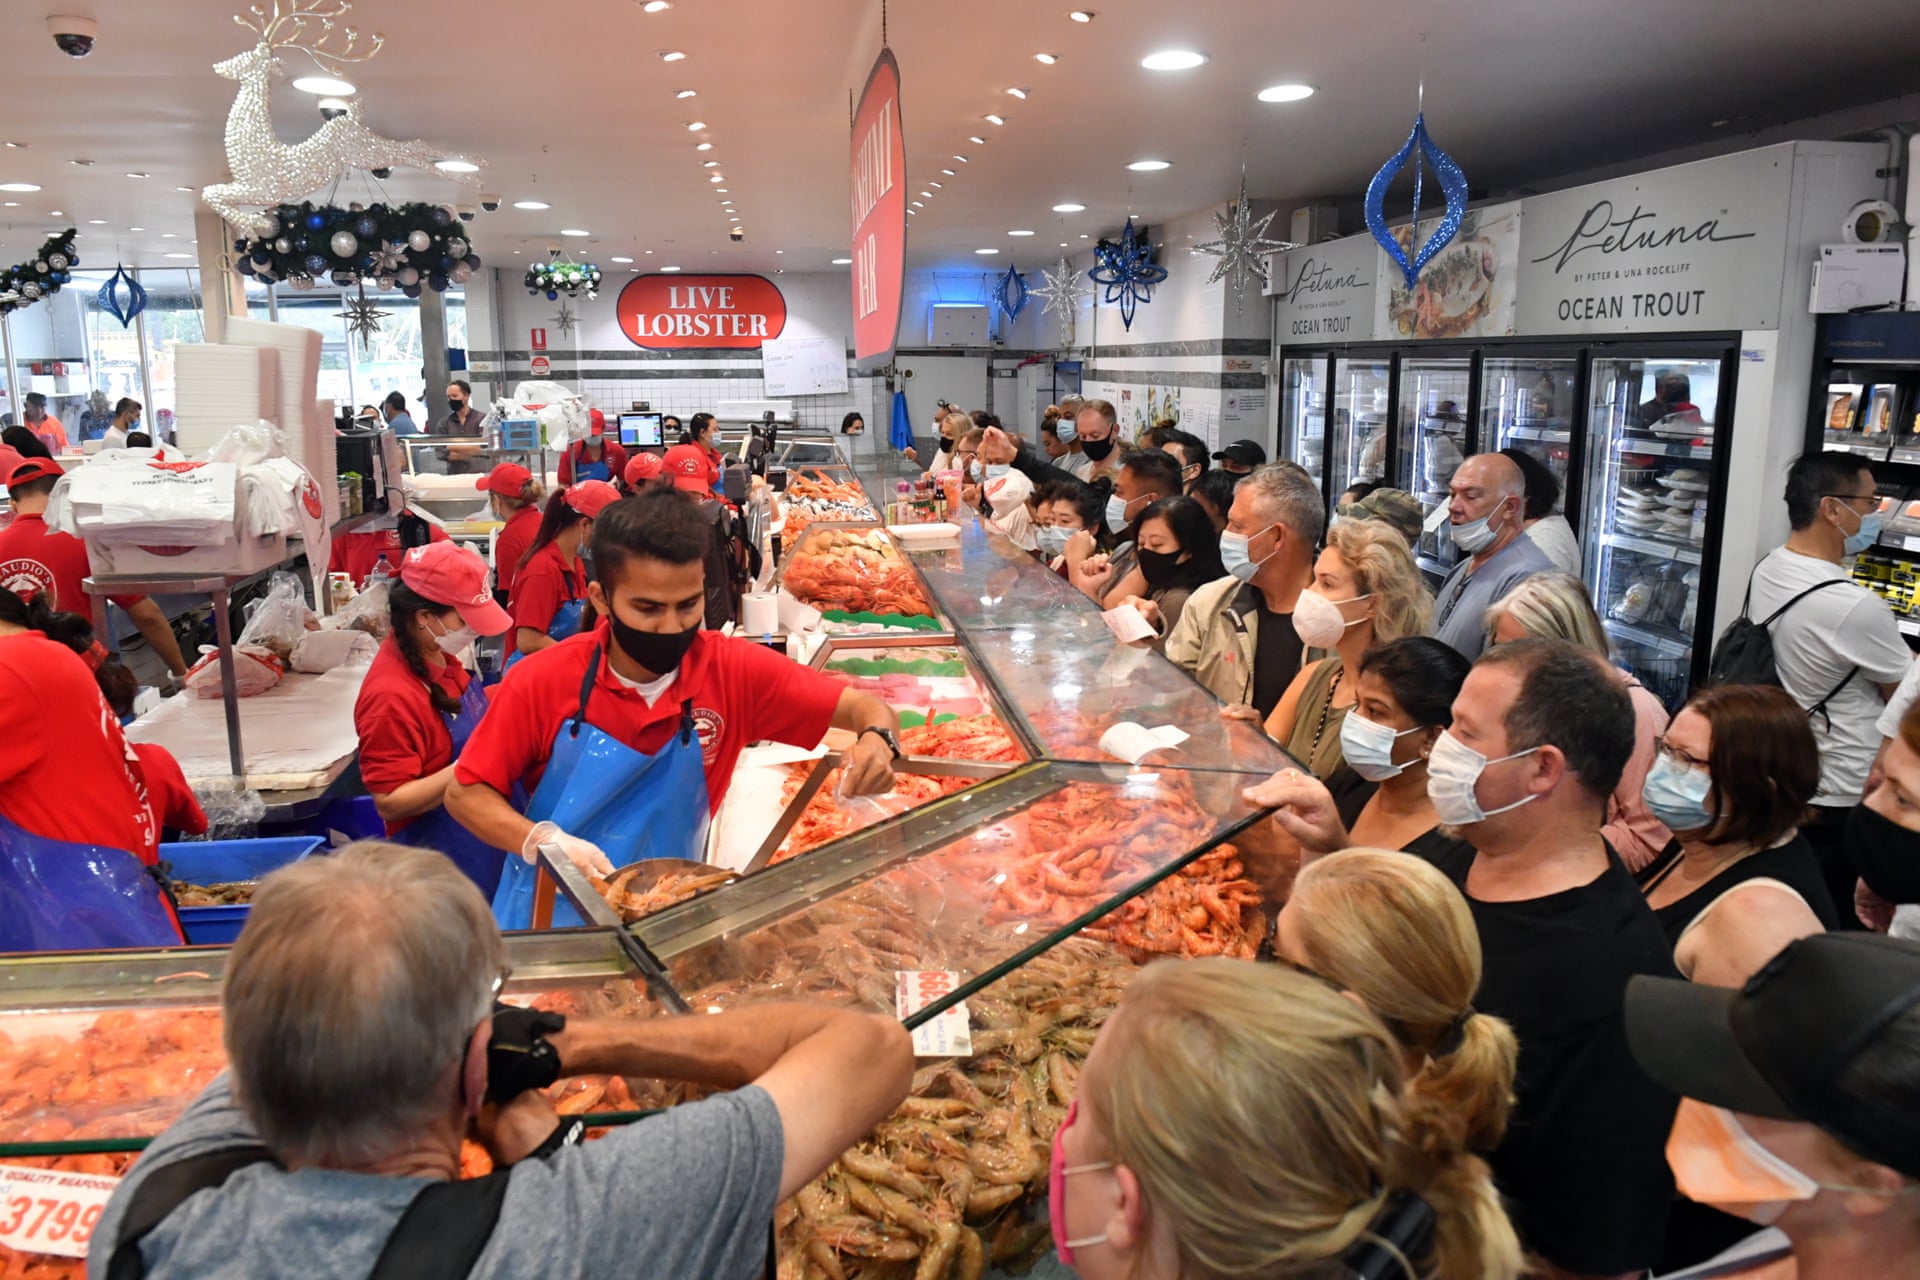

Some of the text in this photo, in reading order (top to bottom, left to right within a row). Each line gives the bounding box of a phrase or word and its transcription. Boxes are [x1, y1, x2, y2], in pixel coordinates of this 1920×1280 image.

[850, 98, 893, 241] ASHIMI
[1531, 200, 1756, 274] Petuna
[858, 234, 878, 319] BAR
[1283, 258, 1370, 304] Petuna
[1574, 263, 1690, 282] BY PETER & UNA ROCKLIFF
[669, 286, 735, 309] LIVE
[1558, 290, 1705, 321] OCEAN TROUT
[636, 313, 768, 337] LOBSTER
[1292, 316, 1351, 335] OCEAN TROUT
[0, 562, 52, 585] AUDIO'S
[5, 1171, 55, 1184] QUALITY
